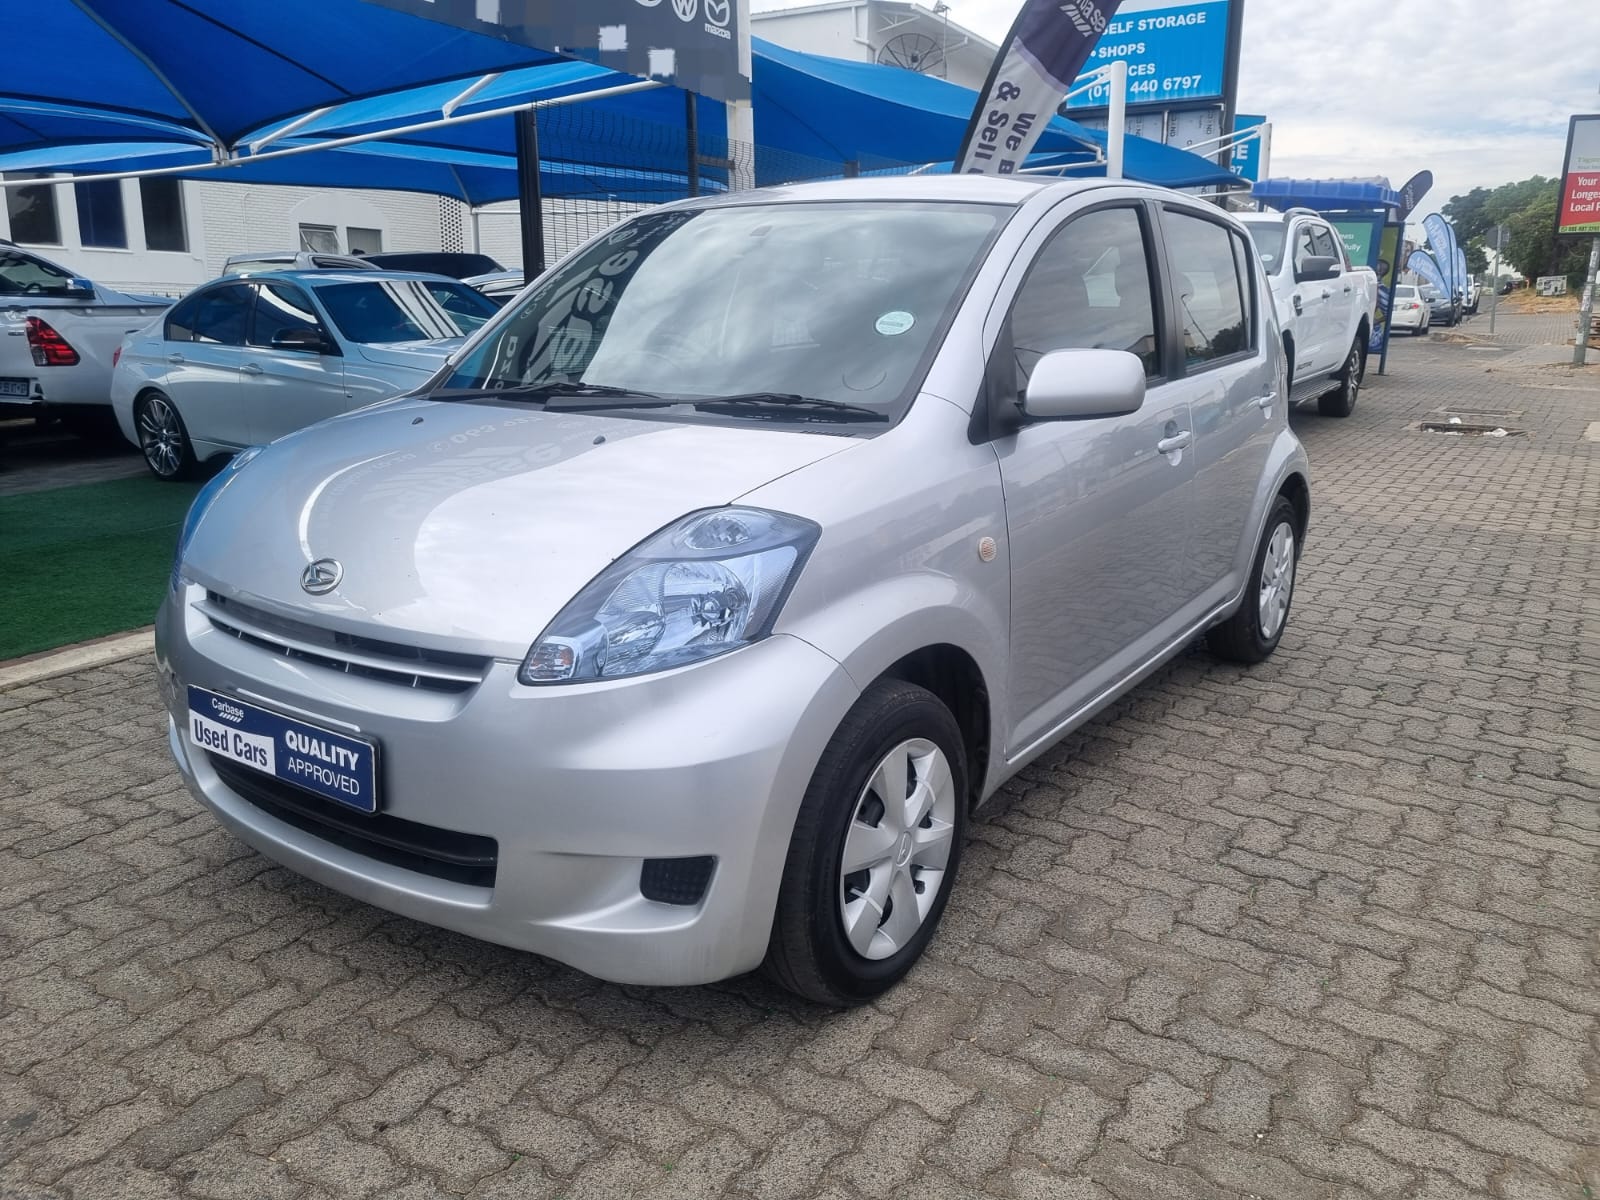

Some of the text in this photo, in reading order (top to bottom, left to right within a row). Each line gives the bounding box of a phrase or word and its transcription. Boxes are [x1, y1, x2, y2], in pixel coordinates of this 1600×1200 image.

[704, 22, 731, 39] mazda
[1138, 12, 1207, 32] STORAGE
[1098, 43, 1146, 59] SHOPS
[1129, 78, 1159, 94] 440
[1162, 75, 1202, 91] 6797
[974, 81, 1021, 161] & Sell
[1005, 112, 1037, 152] We
[1577, 176, 1598, 187] Your
[1569, 202, 1594, 212] Local
[211, 697, 245, 718] Carbase
[193, 718, 268, 767] Used Cars
[284, 729, 360, 771] QUALITY
[287, 758, 361, 796] APPROVED
